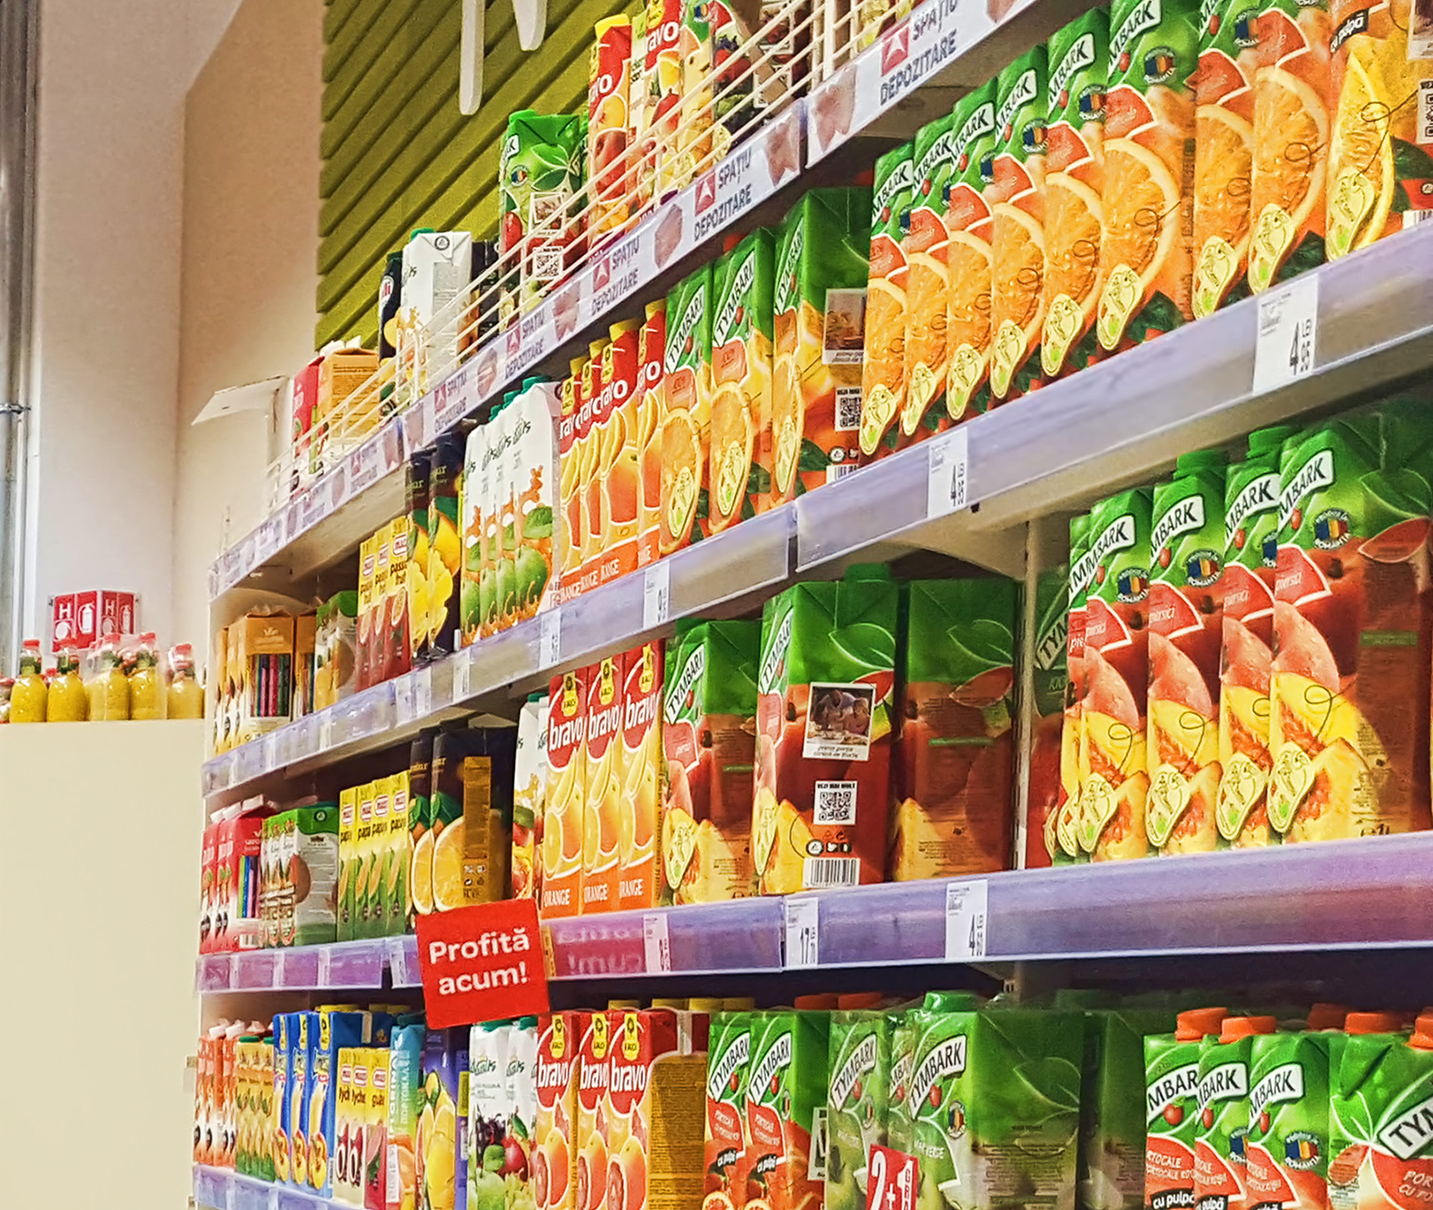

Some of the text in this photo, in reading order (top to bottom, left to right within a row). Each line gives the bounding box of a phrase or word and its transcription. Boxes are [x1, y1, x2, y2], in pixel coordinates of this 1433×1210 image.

[880, 30, 957, 106] DEPOZITARE
[58, 602, 71, 619] H
[548, 716, 586, 750] bravo
[544, 889, 571, 906] ORANGE
[429, 925, 531, 964] Profită
[438, 961, 529, 996] acum!
[538, 1056, 569, 1086] bravo
[610, 1057, 645, 1091] bravo
[752, 1037, 791, 1094] TYMBARK
[834, 1038, 875, 1102] TYMBARK
